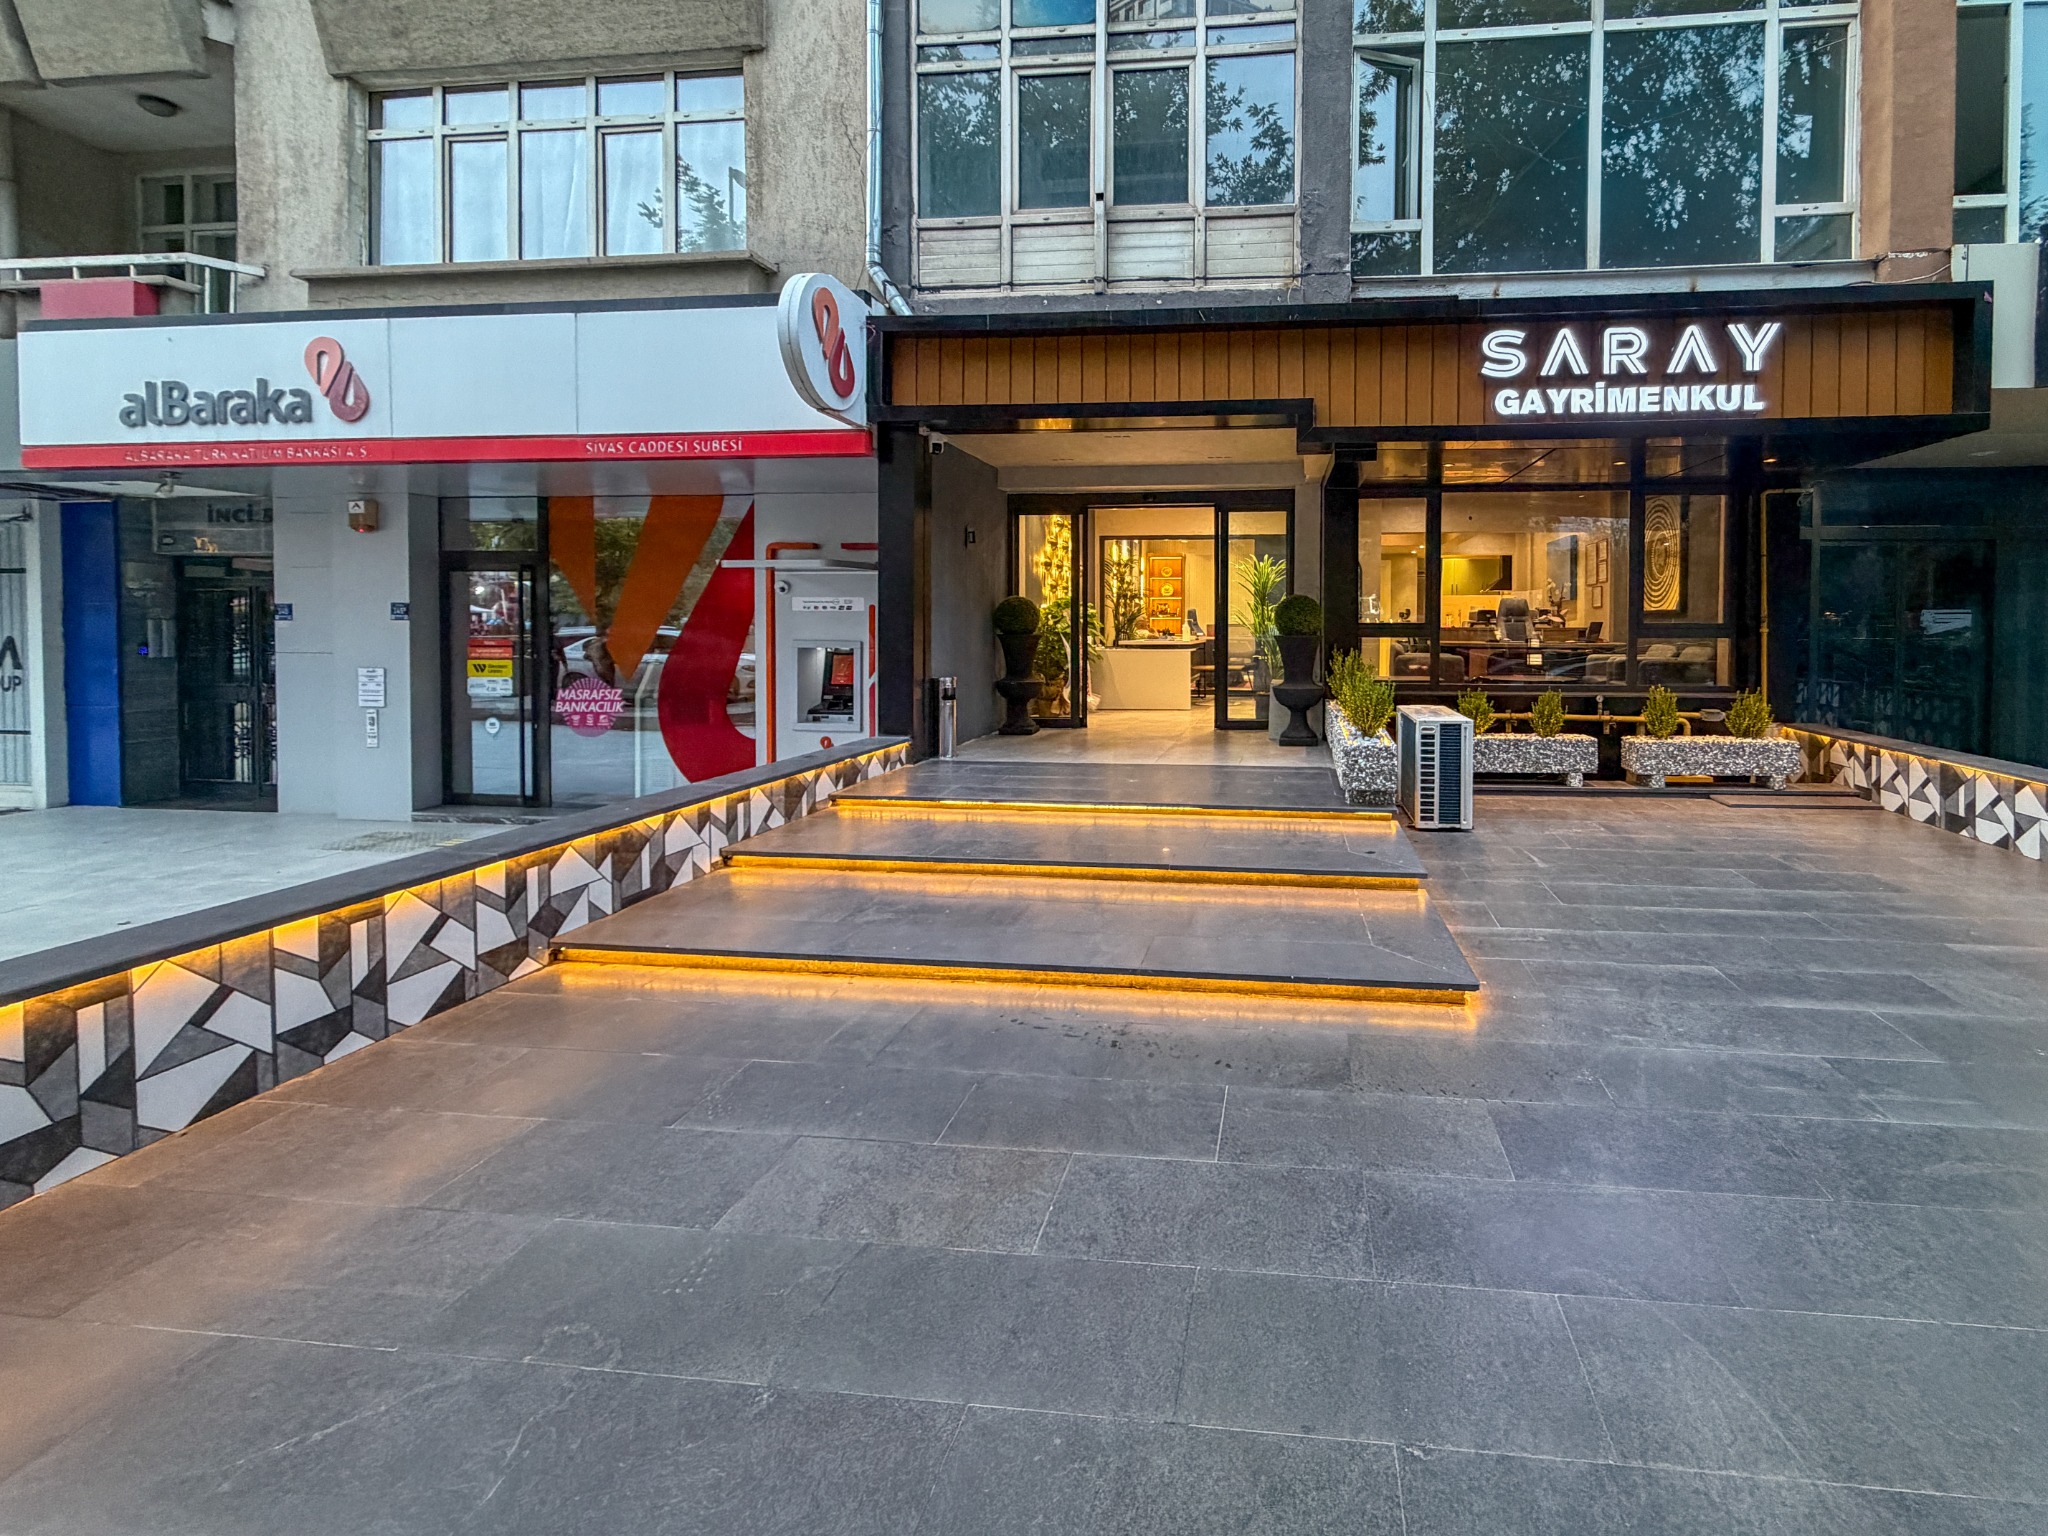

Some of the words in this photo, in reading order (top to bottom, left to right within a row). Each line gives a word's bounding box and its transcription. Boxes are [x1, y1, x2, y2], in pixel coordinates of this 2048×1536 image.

[1481, 323, 1781, 377] SARAY
[119, 377, 313, 428] alBaraka
[1494, 381, 1764, 415] GAYRİMENKUL
[555, 701, 625, 712] BANKACILIK
[557, 689, 623, 700] MASRAFSIZ
